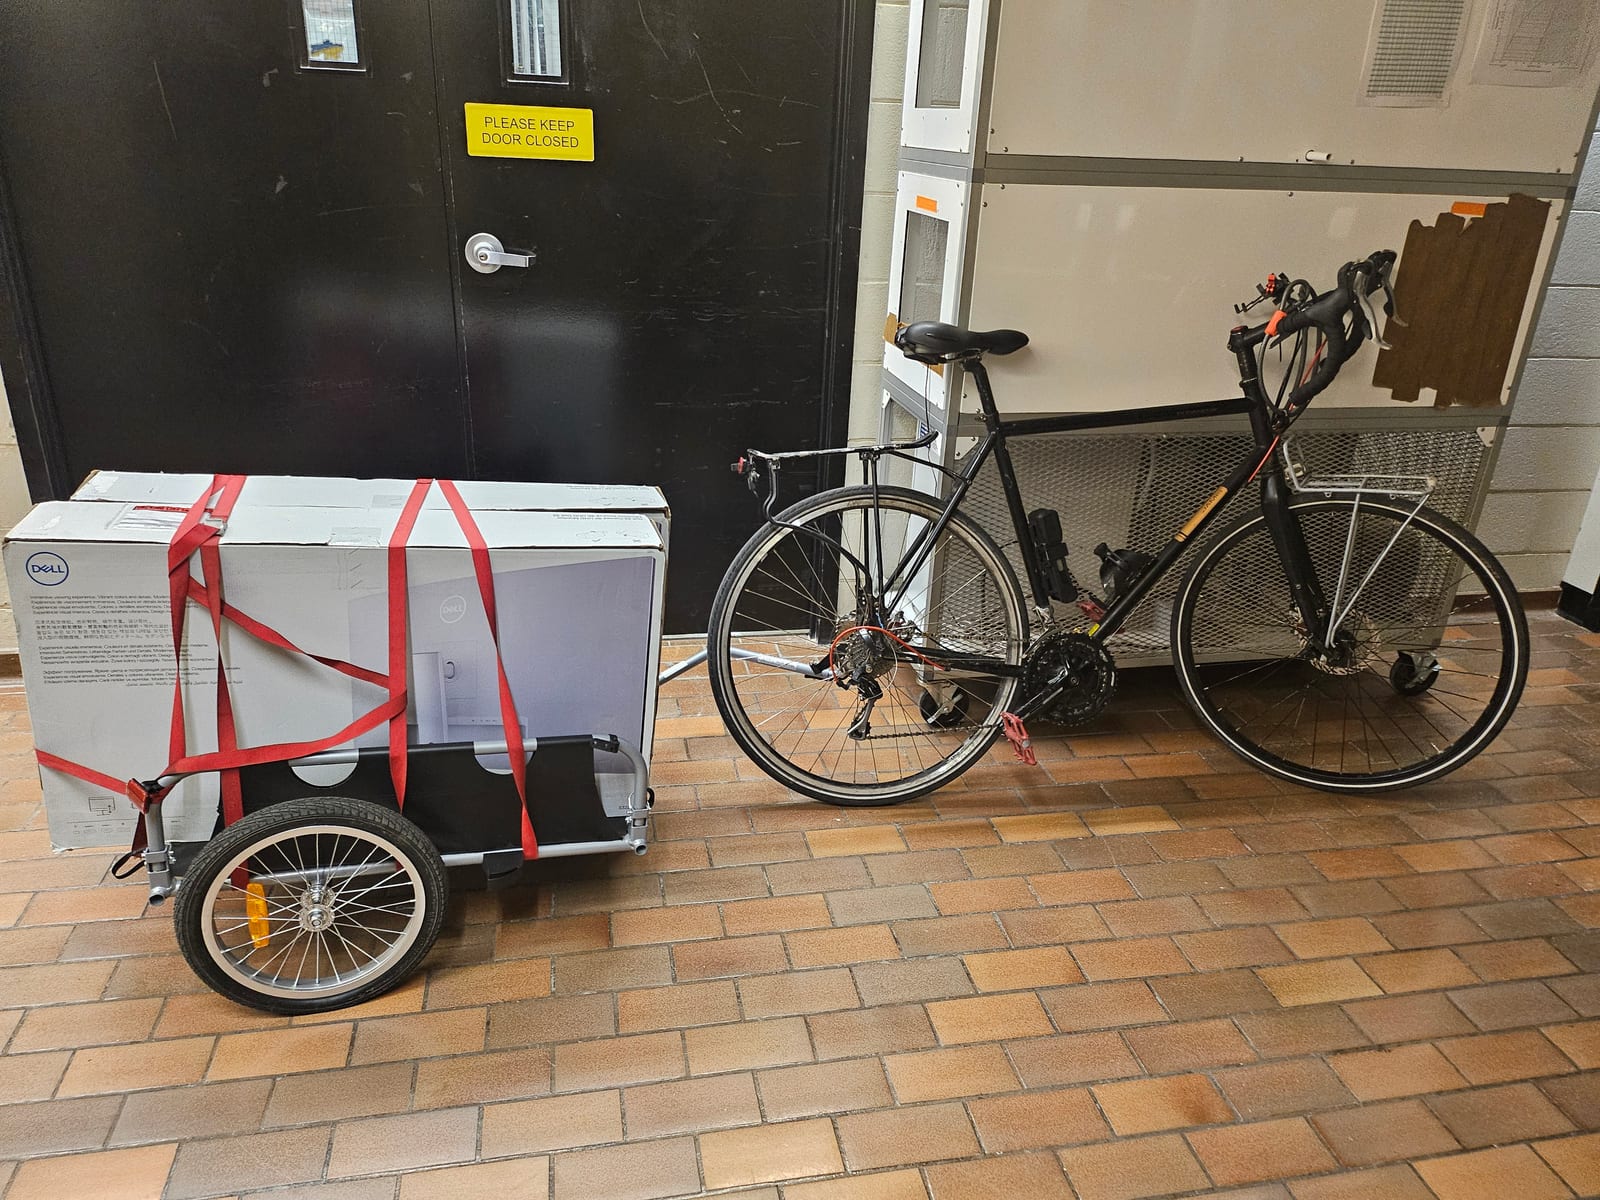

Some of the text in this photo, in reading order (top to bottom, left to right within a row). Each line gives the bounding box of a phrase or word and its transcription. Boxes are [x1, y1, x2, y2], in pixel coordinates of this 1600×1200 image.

[484, 116, 575, 132] PLEASE KEEP
[481, 132, 579, 148] DOOR CLOSED
[31, 564, 65, 573] DELL
